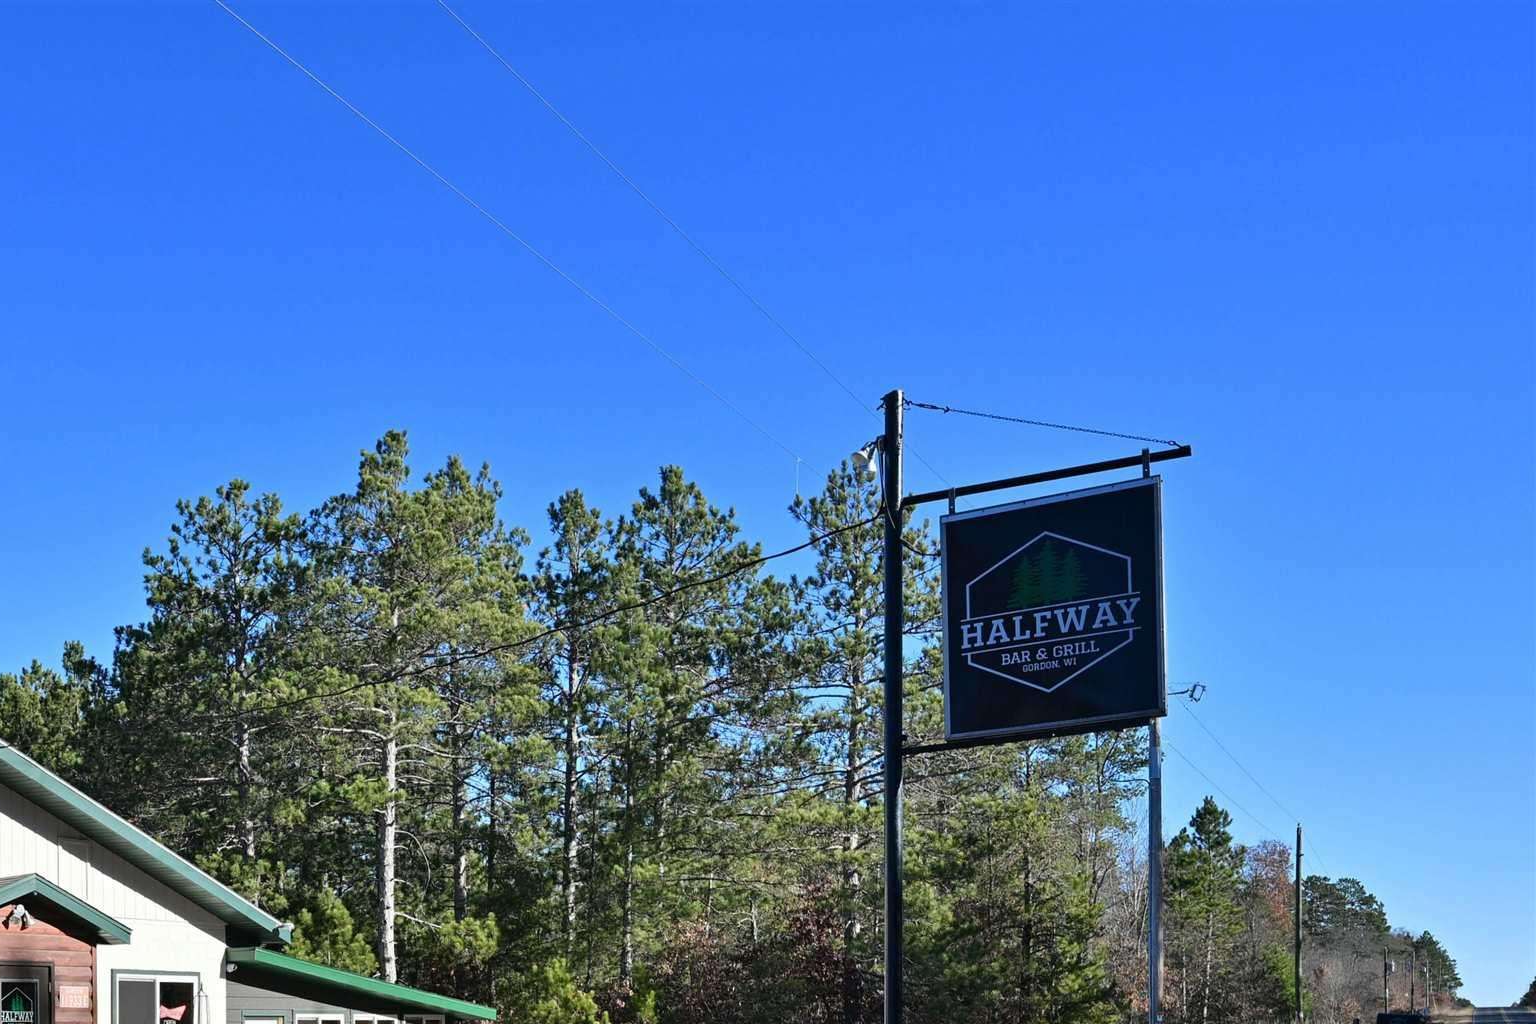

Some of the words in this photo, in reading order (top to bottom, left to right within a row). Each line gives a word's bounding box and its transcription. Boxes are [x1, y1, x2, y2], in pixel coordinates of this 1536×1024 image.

[961, 598, 1140, 649] HALFWAY
[1001, 650, 1031, 665] BAR
[1036, 648, 1048, 660] &
[1053, 641, 1100, 657] GRILL
[1064, 657, 1077, 666] WI
[1, 1010, 33, 1022] HALFWAY
